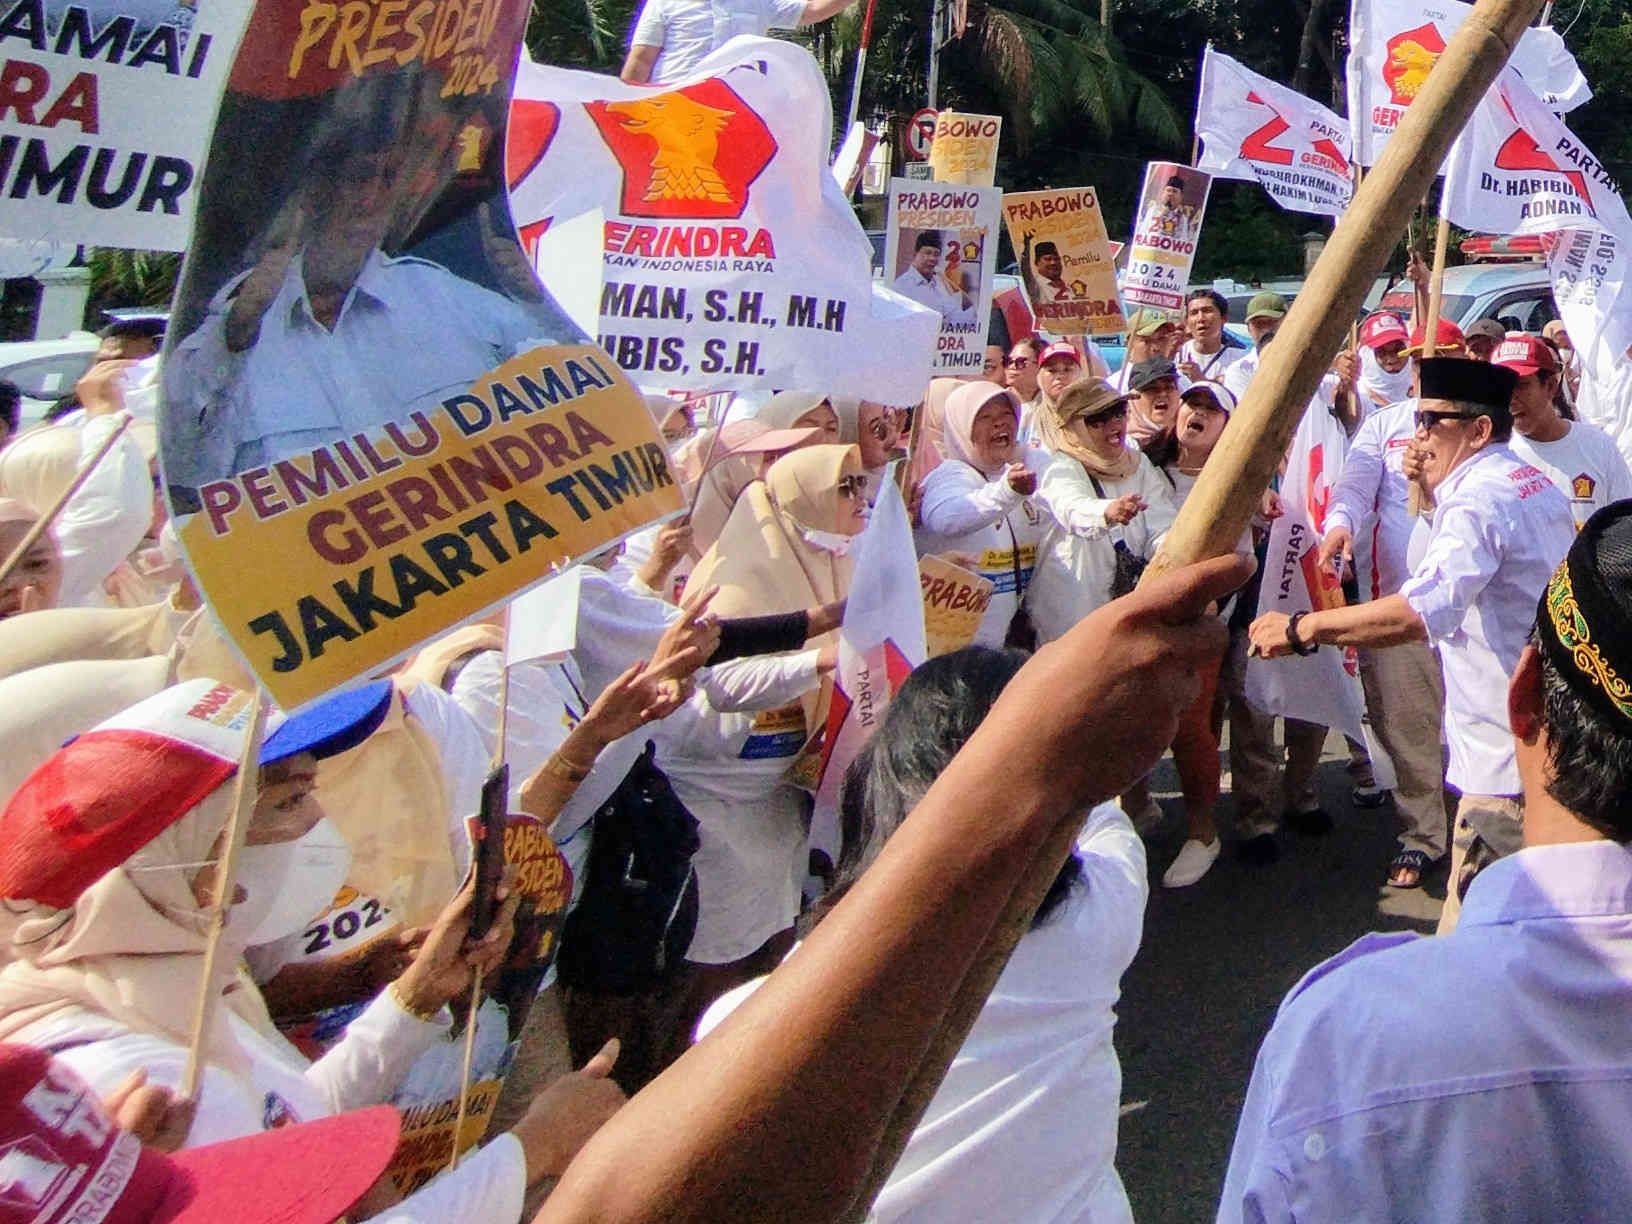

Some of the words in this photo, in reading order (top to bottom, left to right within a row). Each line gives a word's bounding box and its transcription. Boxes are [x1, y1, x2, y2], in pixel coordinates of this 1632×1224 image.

[0, 59, 99, 134] RA
[1310, 120, 1346, 145] PARTAI
[1480, 171, 1503, 195] Dr.
[897, 191, 981, 211] PRABOWO
[1006, 192, 1096, 223] PRABOWO
[1519, 198, 1583, 220] ADNAN
[897, 210, 976, 228] PRESIDEN
[642, 259, 728, 273] INDONESIA
[732, 260, 775, 274] RAYA
[1062, 251, 1102, 268] Pemilu
[703, 289, 777, 329] S.H.,
[786, 294, 847, 333] M.H
[700, 338, 766, 376] S.H.
[941, 353, 983, 367] TIMUR
[201, 411, 441, 537] PEMILU
[441, 356, 616, 437] DAMAI
[307, 410, 614, 566] GERINDRA
[248, 498, 560, 673] JAKARTA
[545, 441, 675, 523] TIMUR
[857, 669, 875, 729] PARTAI
[303, 898, 392, 954] 202
